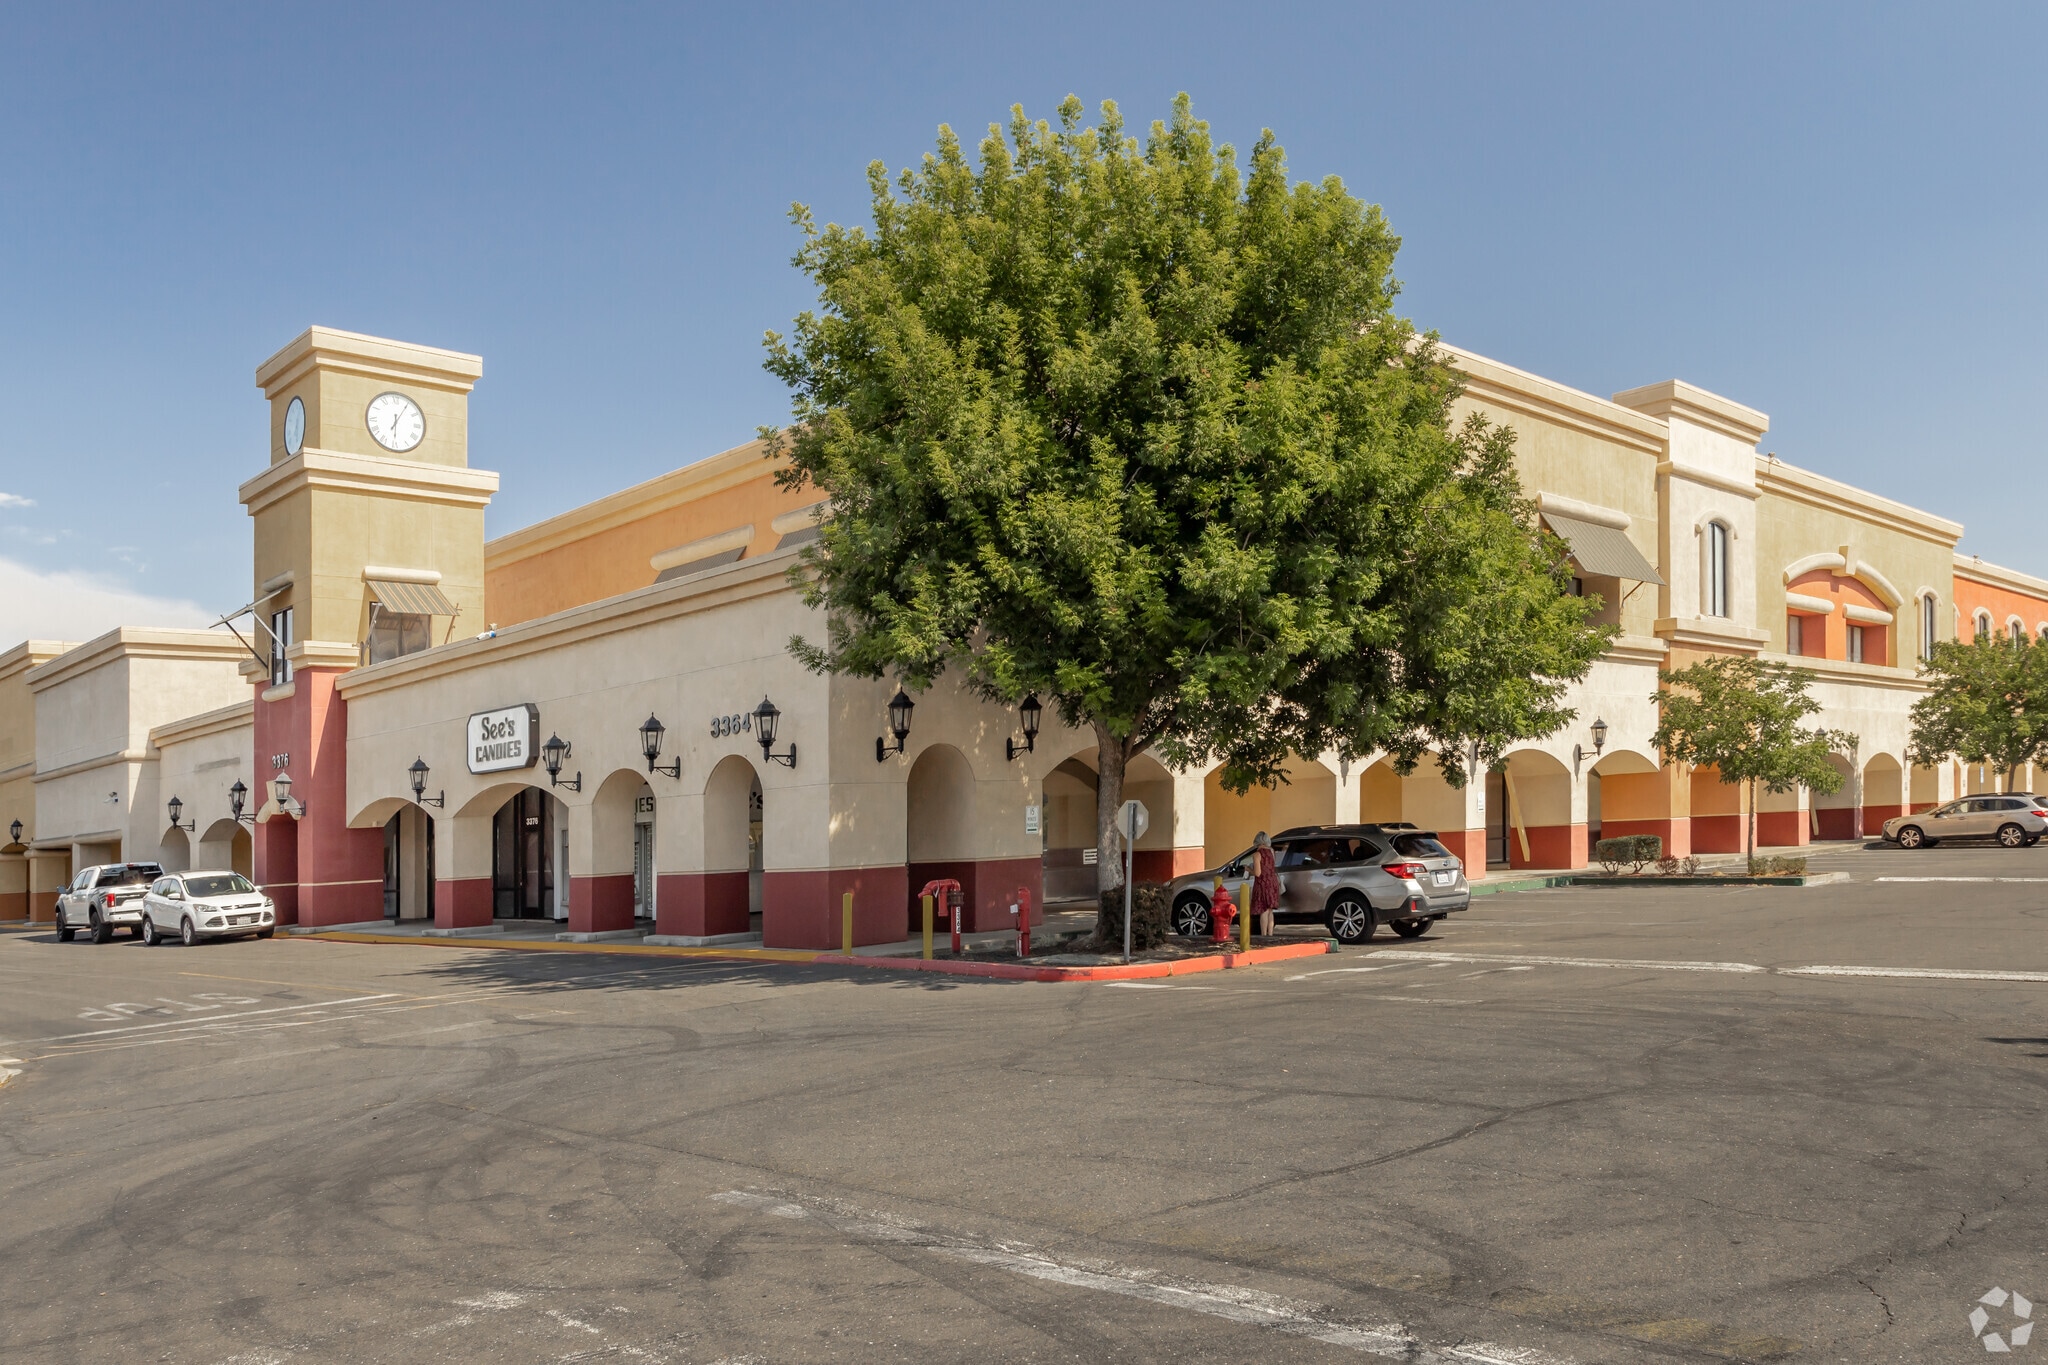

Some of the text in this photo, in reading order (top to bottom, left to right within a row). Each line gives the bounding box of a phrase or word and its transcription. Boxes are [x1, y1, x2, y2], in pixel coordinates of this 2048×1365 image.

[481, 717, 515, 740] See's
[711, 712, 751, 738] 3364
[271, 753, 290, 769] 3376
[475, 740, 522, 763] CANDIES
